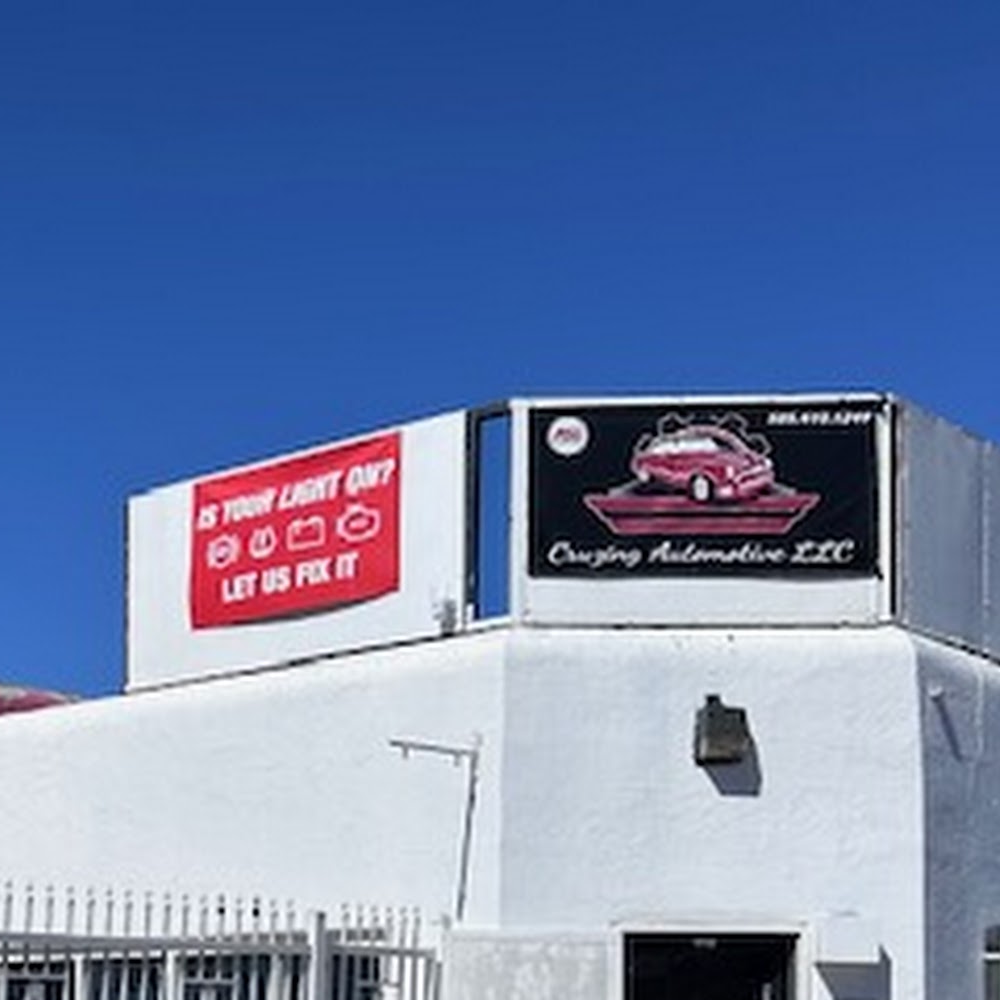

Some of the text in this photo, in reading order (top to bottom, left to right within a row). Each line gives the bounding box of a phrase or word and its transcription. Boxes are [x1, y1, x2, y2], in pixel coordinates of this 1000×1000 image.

[199, 504, 219, 530] IS
[278, 471, 342, 510] LIGHT
[222, 552, 359, 603] LET US FIX IT
[548, 540, 855, 568] Cruzing Automotive LLC
